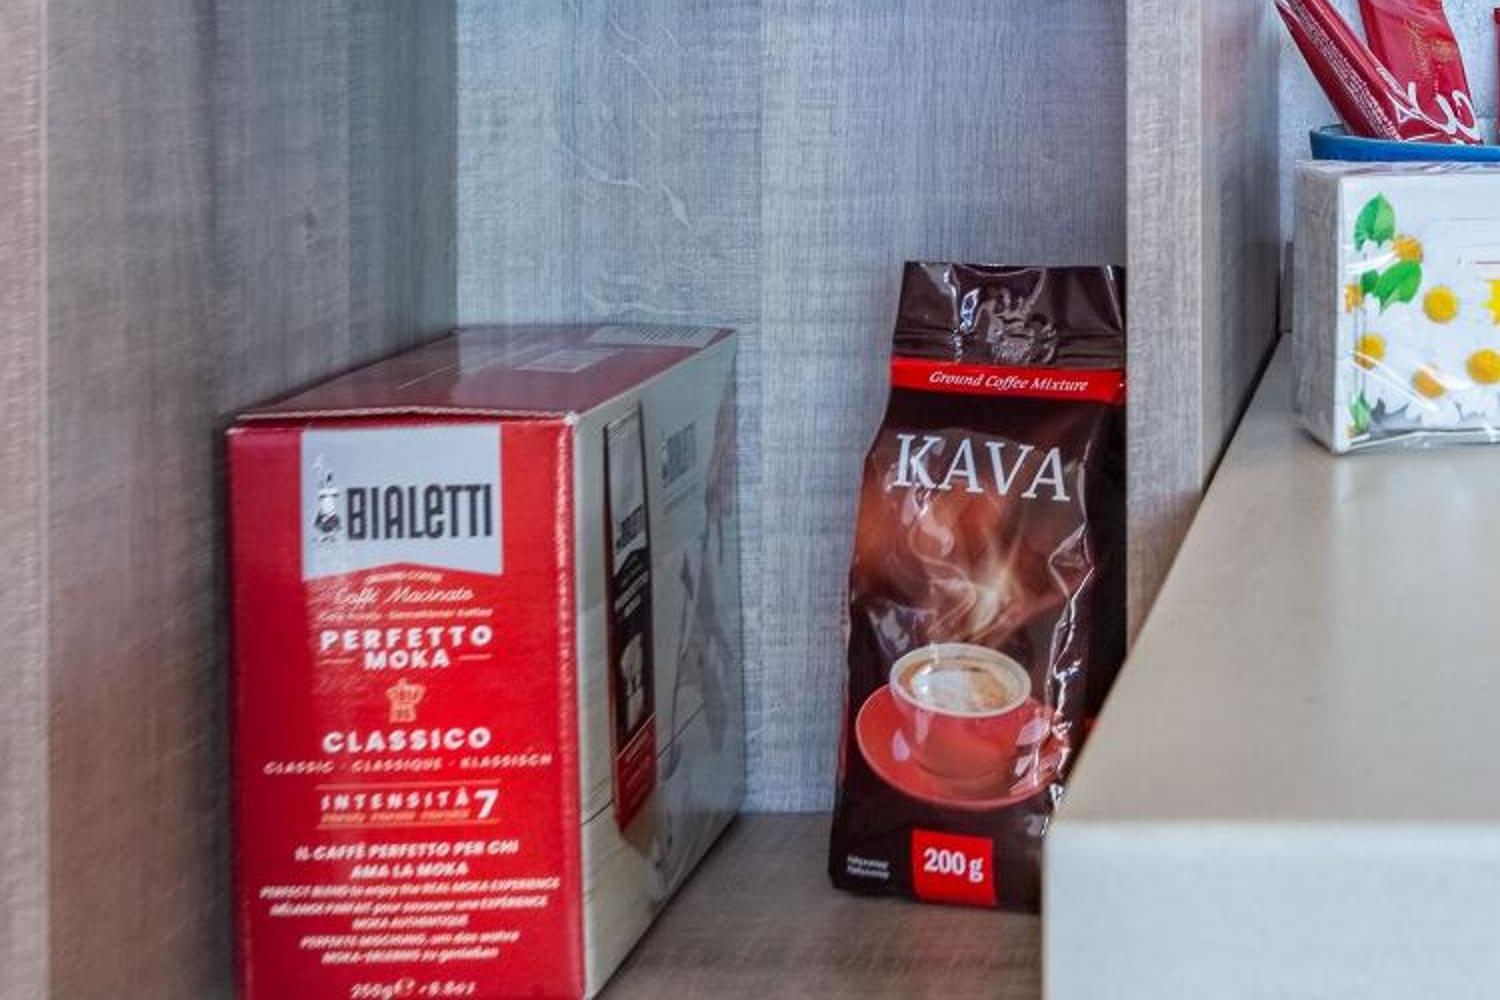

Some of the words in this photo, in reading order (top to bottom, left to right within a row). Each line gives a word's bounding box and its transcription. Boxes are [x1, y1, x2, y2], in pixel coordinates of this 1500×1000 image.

[929, 371, 982, 387] Ground
[985, 375, 1029, 391] Coffee
[1031, 377, 1089, 392] Mixture
[893, 433, 1070, 501] KAVA
[319, 625, 494, 652] PERFETTO
[363, 650, 451, 671] MOKA
[321, 726, 492, 754] CLASSICO
[263, 760, 333, 775] CLASSIC
[474, 788, 498, 820] 7
[923, 848, 966, 875] 200
[968, 857, 984, 883] g
